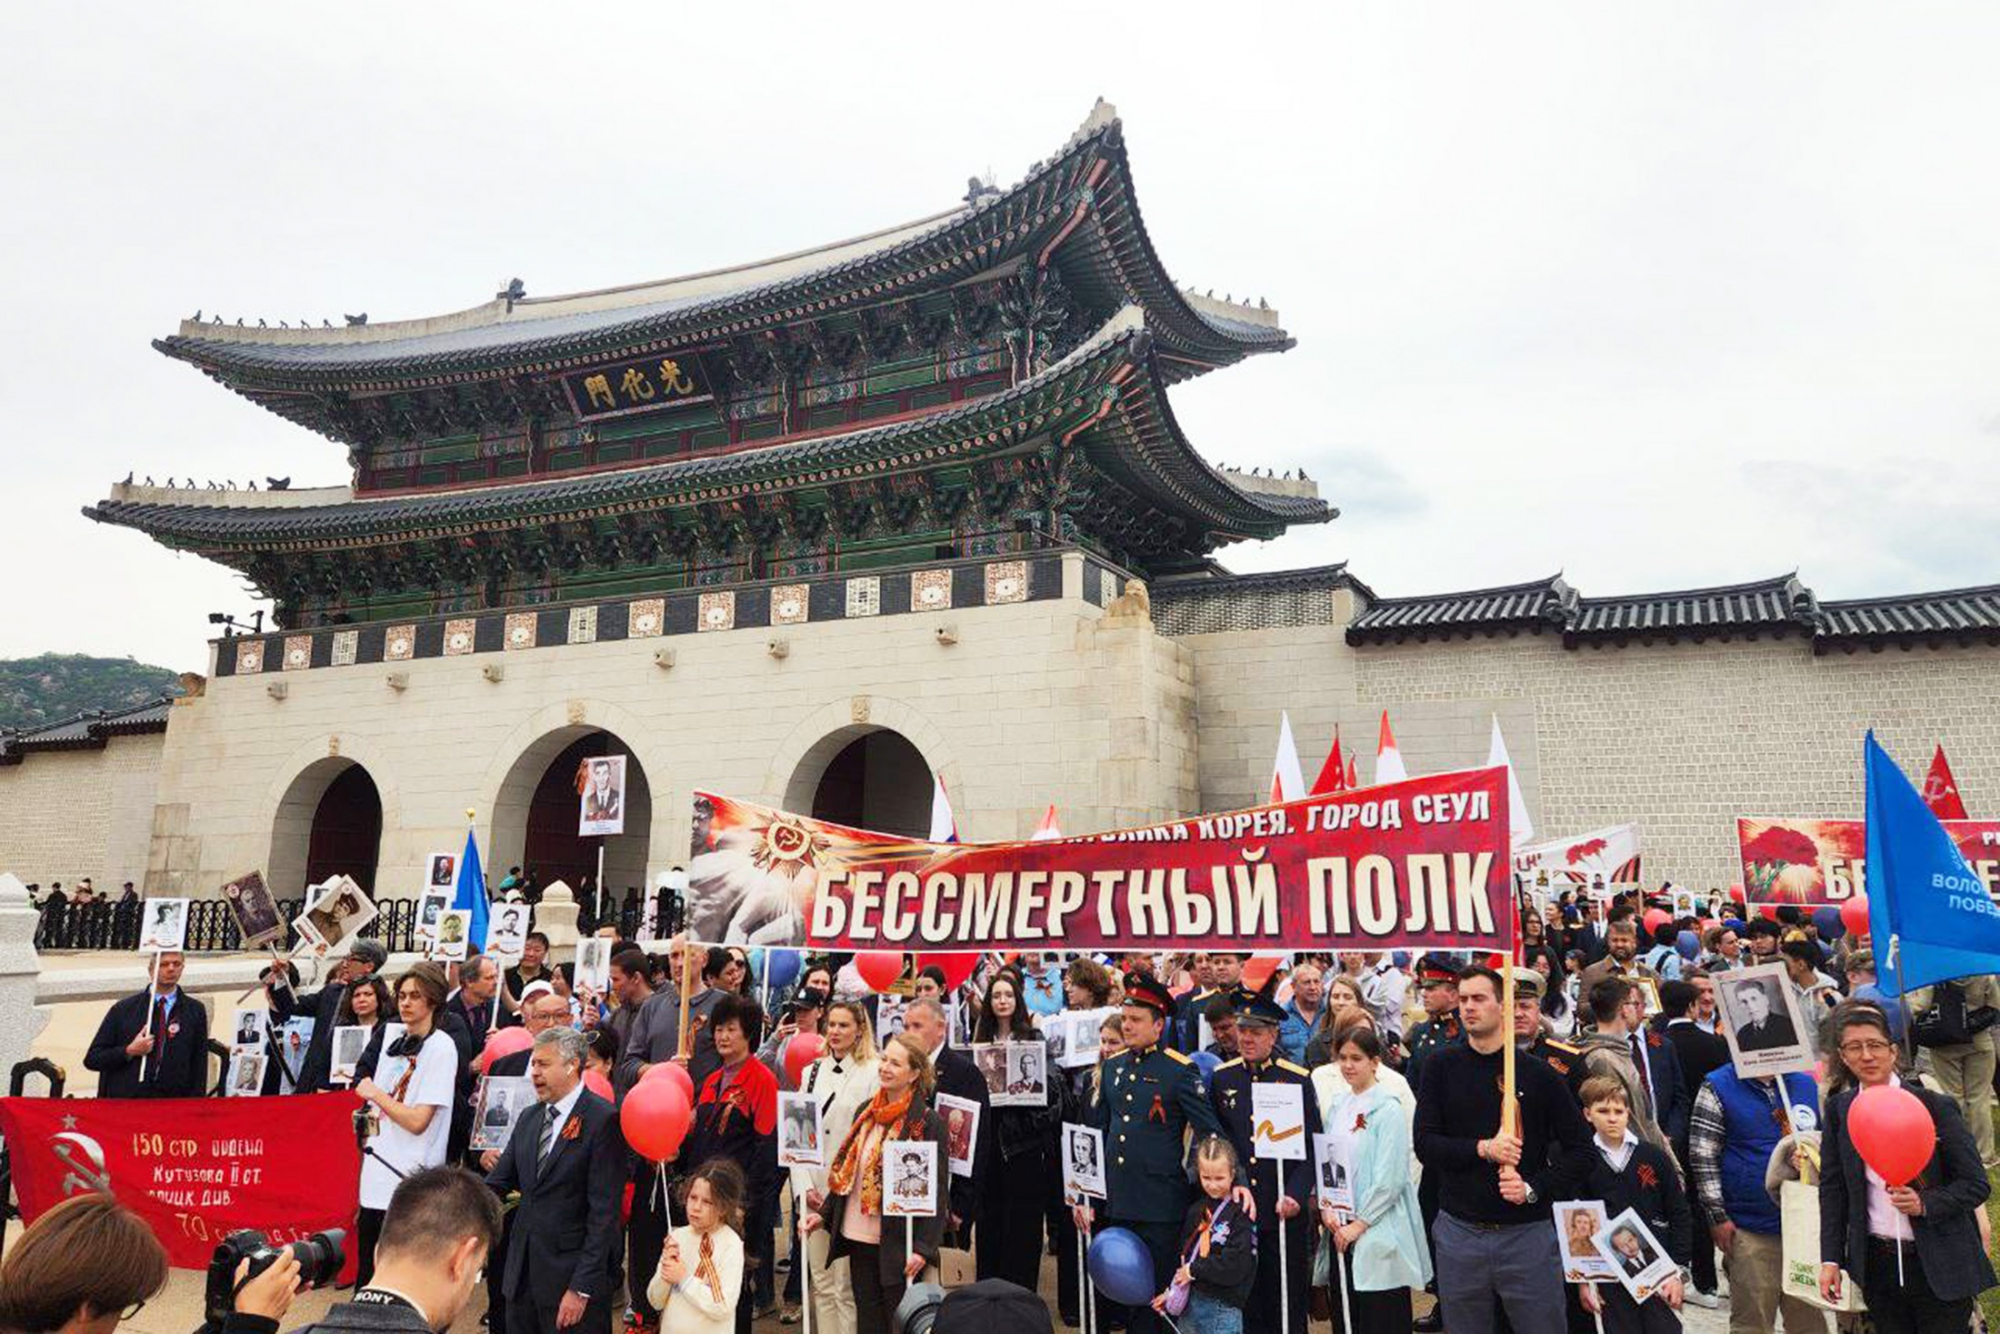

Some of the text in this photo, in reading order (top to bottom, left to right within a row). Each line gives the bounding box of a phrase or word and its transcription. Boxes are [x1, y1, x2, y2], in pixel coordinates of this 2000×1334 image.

[1199, 809, 1294, 839] КОРЕЯ.
[1307, 799, 1402, 831] ГОРОД
[1412, 791, 1490, 823] СЕУЛ
[811, 846, 1495, 942] БЕССМЕРТНЫЙ ПОЛК
[133, 1133, 163, 1157] 150
[354, 1291, 394, 1305] SONY
